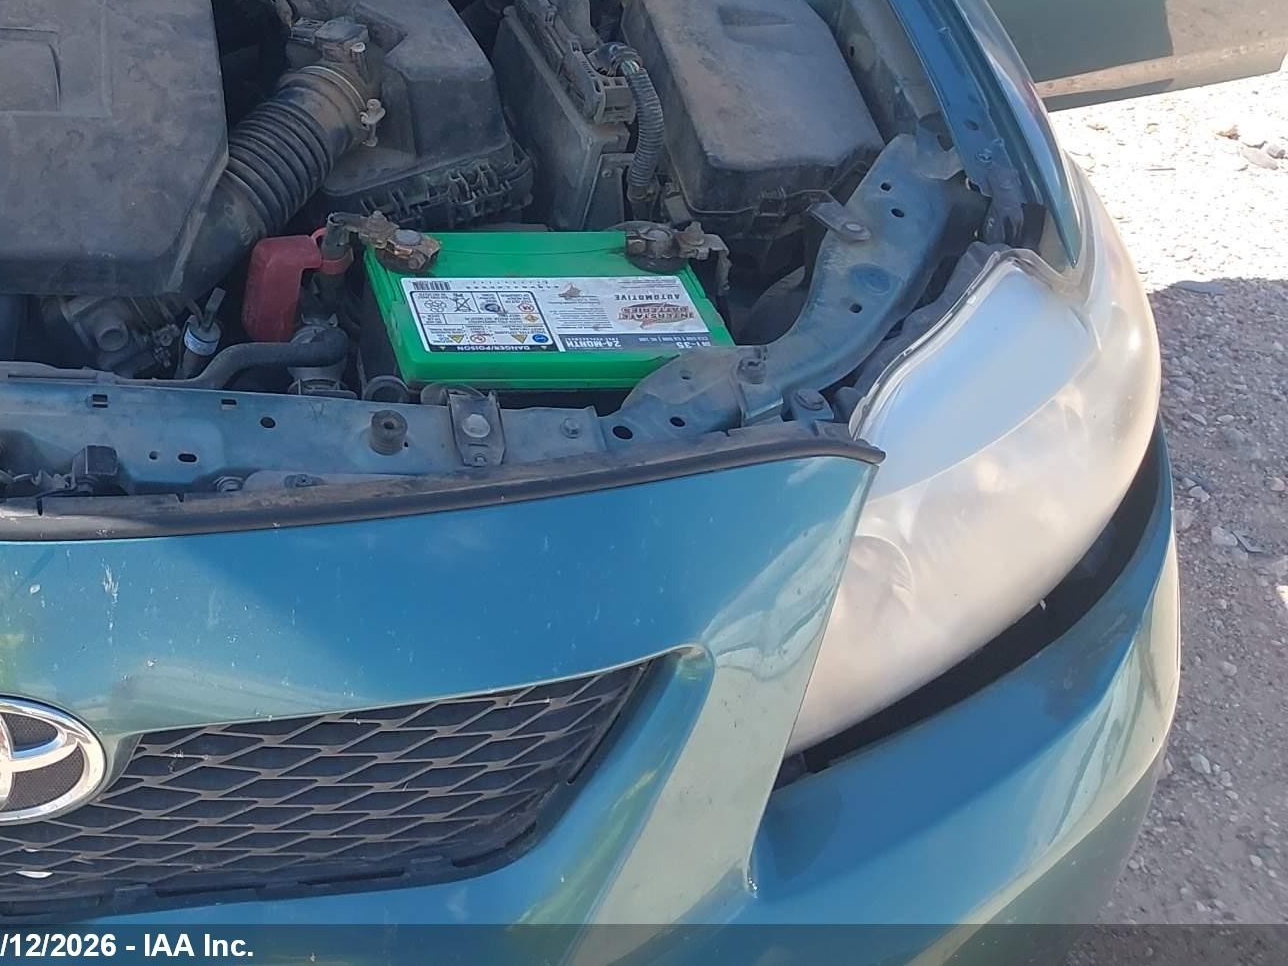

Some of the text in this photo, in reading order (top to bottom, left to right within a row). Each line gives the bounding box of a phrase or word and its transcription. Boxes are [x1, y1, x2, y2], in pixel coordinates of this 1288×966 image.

[615, 293, 680, 301] AUTOMOTIVE
[621, 306, 690, 314] BATTERIES
[618, 311, 695, 321] INTERSTATE
[565, 339, 621, 348] 24-MONTH
